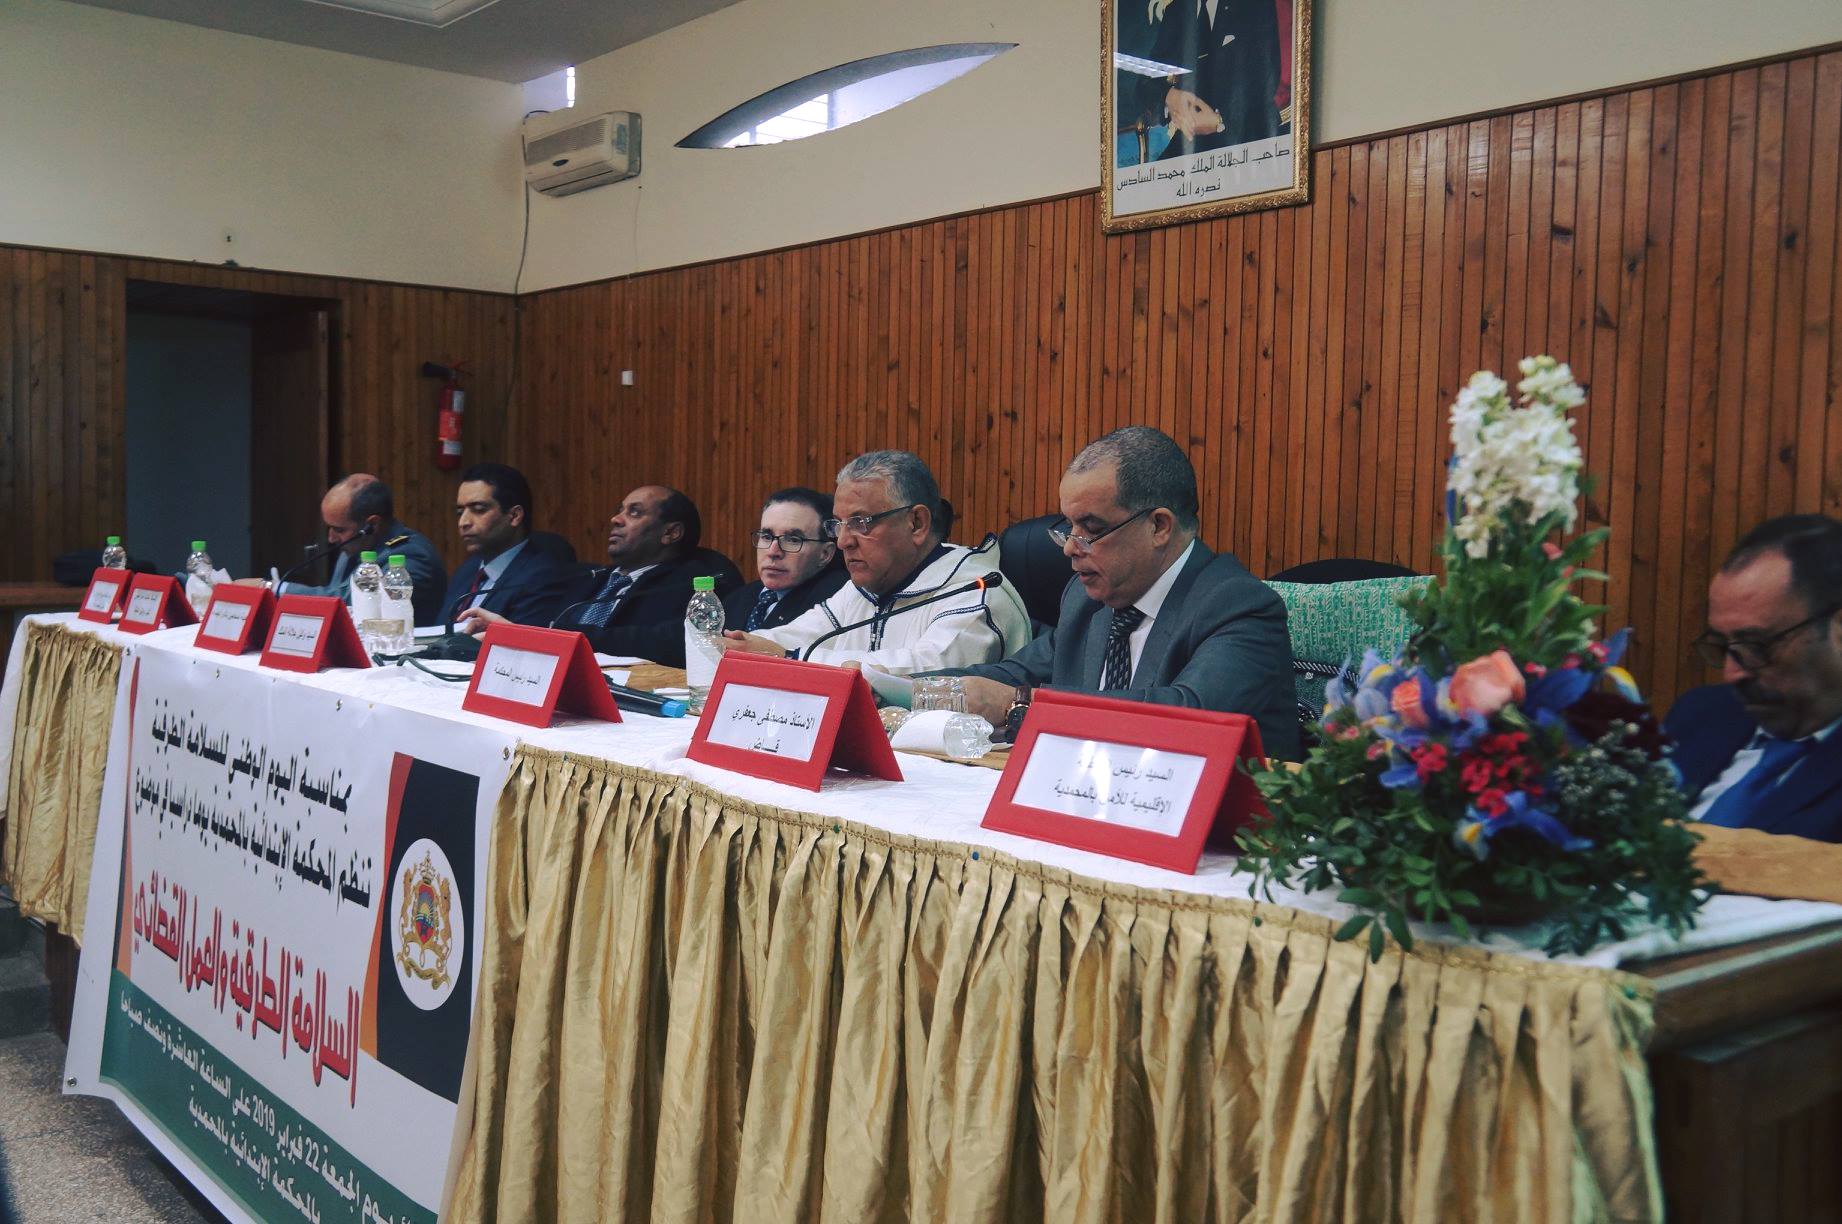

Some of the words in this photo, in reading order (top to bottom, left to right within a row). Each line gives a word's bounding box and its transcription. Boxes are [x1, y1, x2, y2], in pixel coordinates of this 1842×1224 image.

[1117, 167, 1155, 190] السادس
[1157, 167, 1185, 180] محمد
[1190, 155, 1215, 174] الملك
[1218, 147, 1249, 169] الجلالة
[1251, 142, 1290, 164] صاحب
[1176, 182, 1192, 197] الله
[1195, 178, 1221, 197] نصره
[152, 697, 186, 756] الطرقية
[187, 709, 230, 766] للسلامة
[732, 704, 756, 722] جعفري
[135, 765, 160, 815] موضوع
[228, 737, 267, 800] الوطني
[266, 753, 298, 806] اليوم
[299, 746, 352, 833] بمناسبة
[1055, 778, 1098, 803] بالمحمدية
[1146, 767, 1174, 782] السيد
[159, 763, 169, 840] في
[169, 778, 193, 834] دراسيا
[193, 787, 210, 848] يوما
[211, 784, 249, 867] بالمحمدية
[293, 819, 336, 895] المحكمة
[336, 849, 371, 915] تنظم
[134, 869, 187, 985] القضائي
[185, 894, 228, 1015] والعمل
[121, 989, 143, 1028] صباحا
[230, 919, 292, 1061] الطرقية
[143, 1008, 167, 1054] ونصف
[167, 1023, 199, 1073] العاشرة
[291, 955, 360, 1110] السلامة
[200, 1048, 231, 1100] الساعة
[189, 1084, 229, 1155] بالمحمدية
[232, 1087, 251, 1117] على
[253, 1094, 275, 1137] 2019
[276, 1124, 303, 1165] فبراير
[305, 1137, 320, 1173] 22
[272, 1157, 321, 1224] بالمحكمة
[321, 1144, 360, 1214] الجمعة
